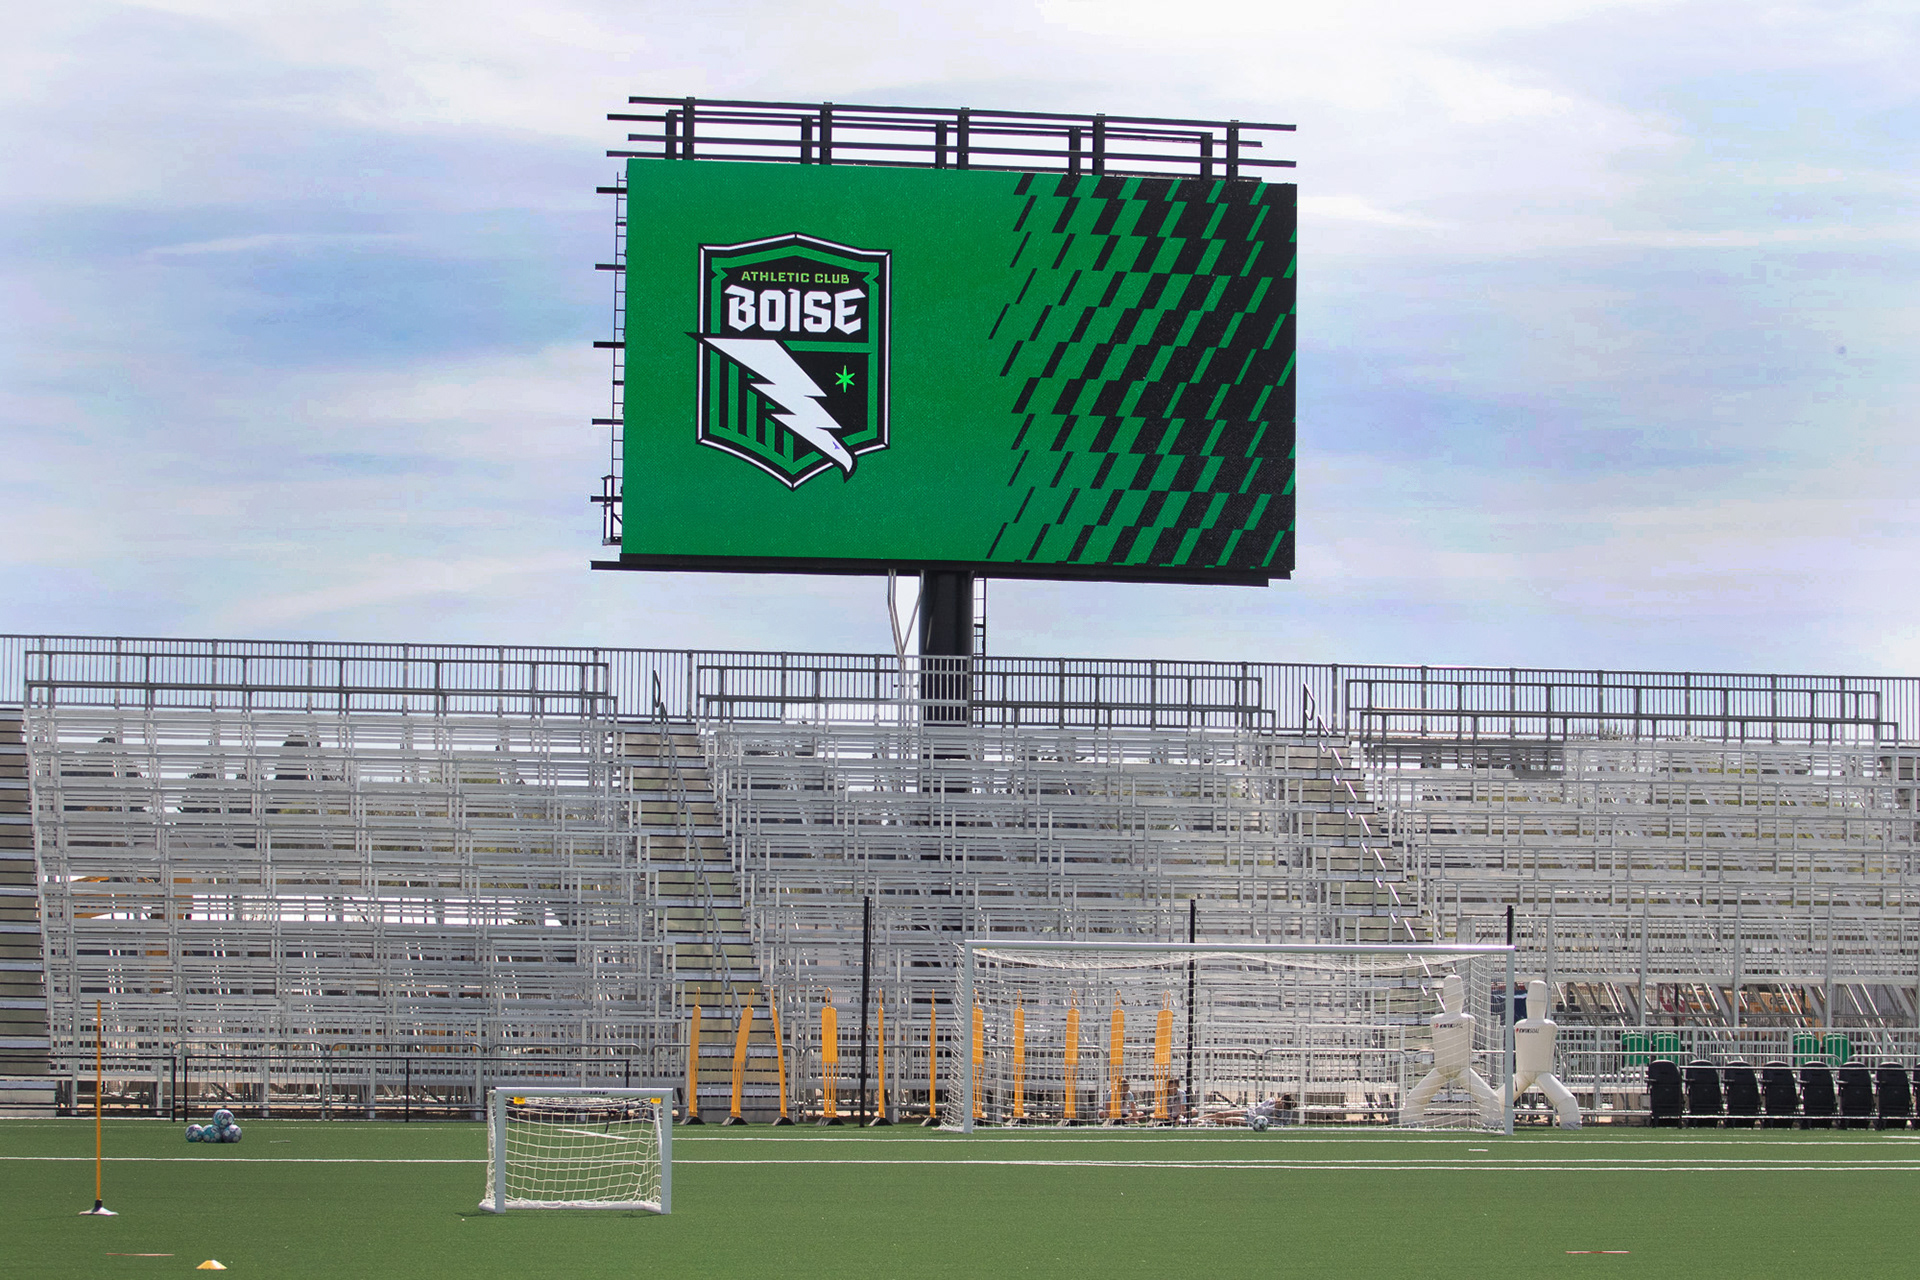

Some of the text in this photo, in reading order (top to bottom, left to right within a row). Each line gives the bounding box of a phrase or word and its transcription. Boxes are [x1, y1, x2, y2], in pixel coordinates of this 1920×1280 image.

[741, 271, 850, 284] ATHLETIC CLUB
[724, 284, 866, 335] BOISE
